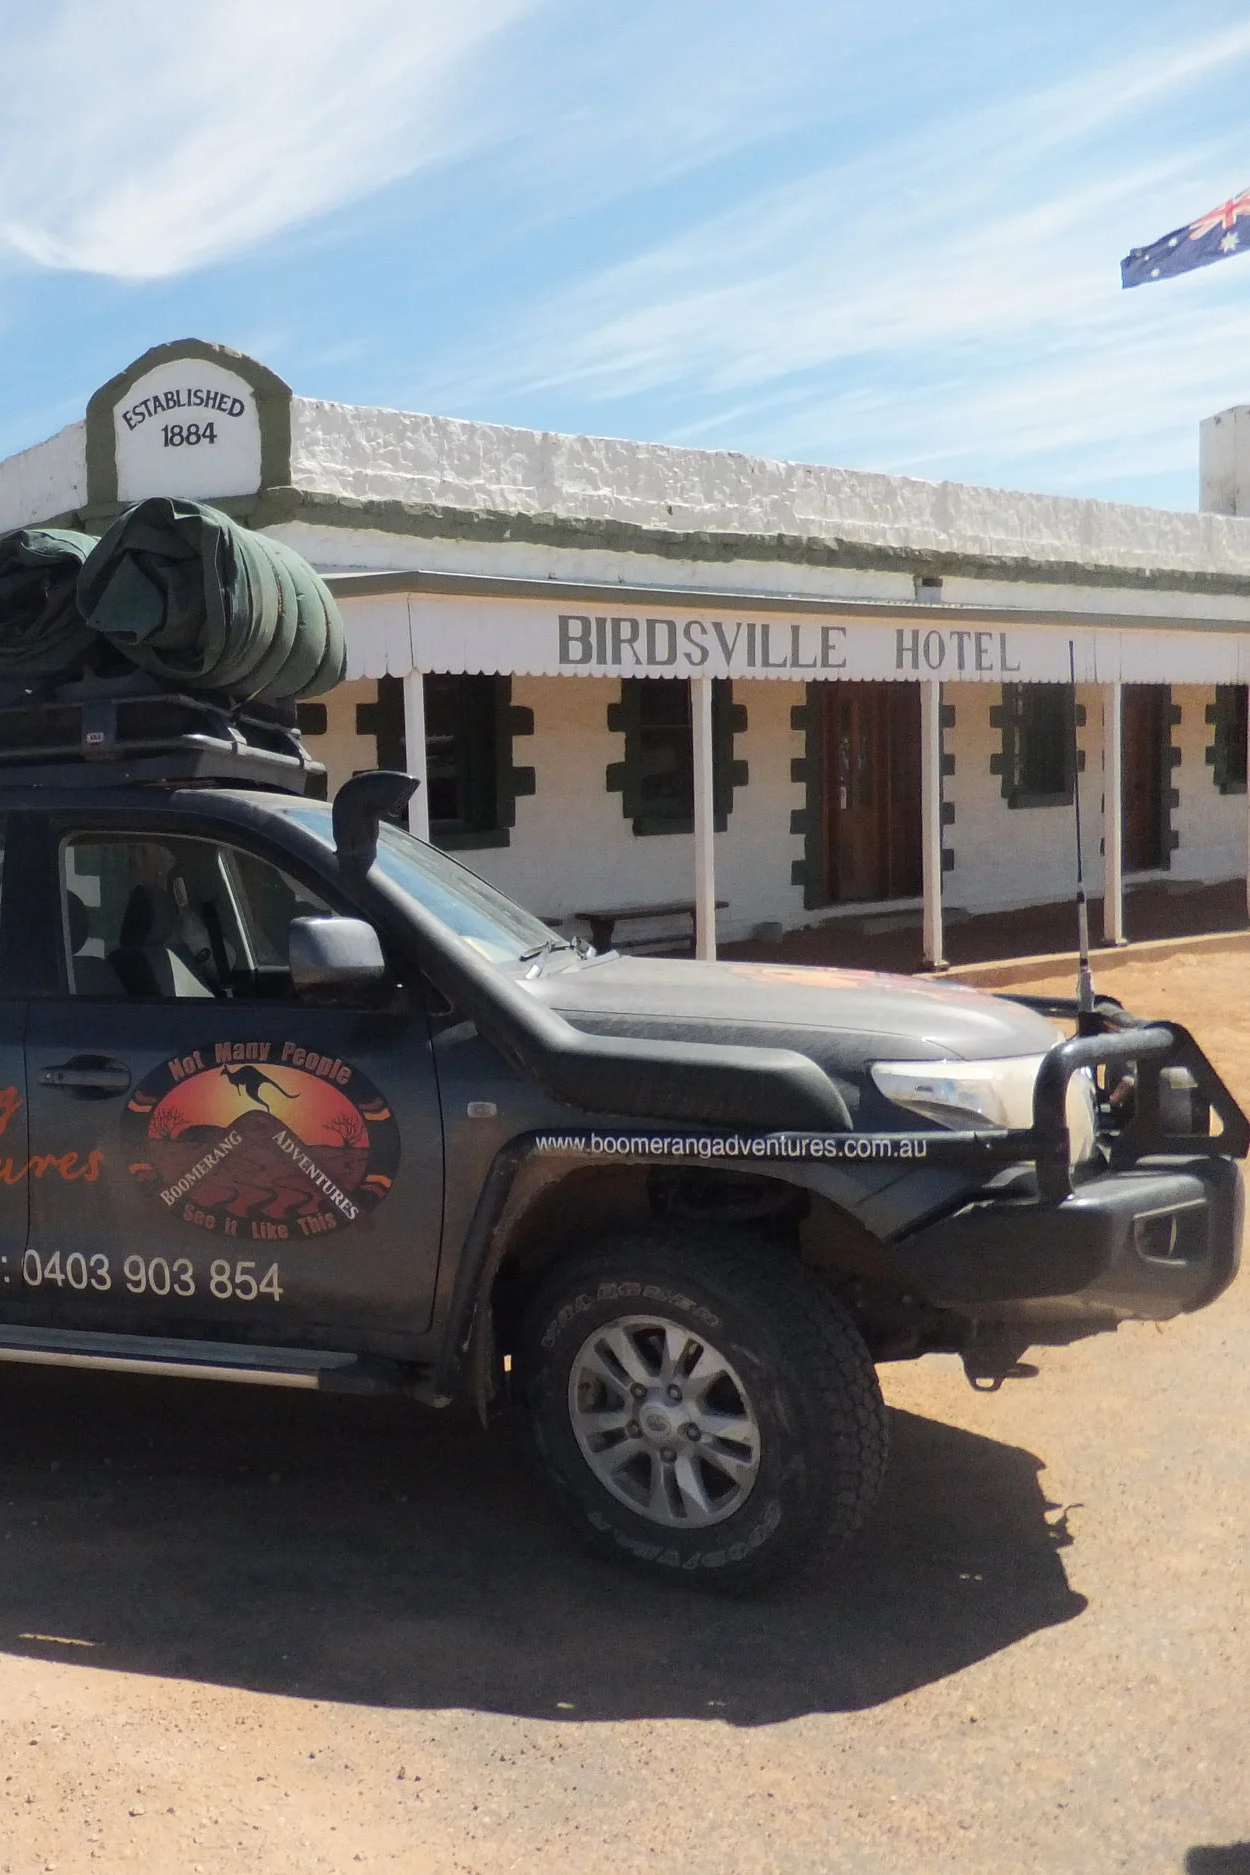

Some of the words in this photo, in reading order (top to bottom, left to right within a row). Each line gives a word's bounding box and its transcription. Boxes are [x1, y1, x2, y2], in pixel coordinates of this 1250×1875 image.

[122, 389, 245, 431] ESTABLISHED
[161, 422, 217, 447] 1884
[558, 615, 847, 668] BIRDSVILLE
[896, 629, 1021, 671] HOTEL
[168, 1050, 205, 1081] Not
[215, 1041, 271, 1063] Many
[281, 1041, 352, 1085] People
[534, 1132, 927, 1158] www.boomerangadventures.com.au
[160, 1130, 243, 1206] BOOMERANG
[272, 1130, 359, 1220] ADVENTURES
[183, 1203, 216, 1230] See
[251, 1221, 289, 1239] Like
[297, 1212, 337, 1236] This
[22, 1249, 111, 1291] 0403
[123, 1254, 196, 1297] 903
[209, 1259, 284, 1302] 854
